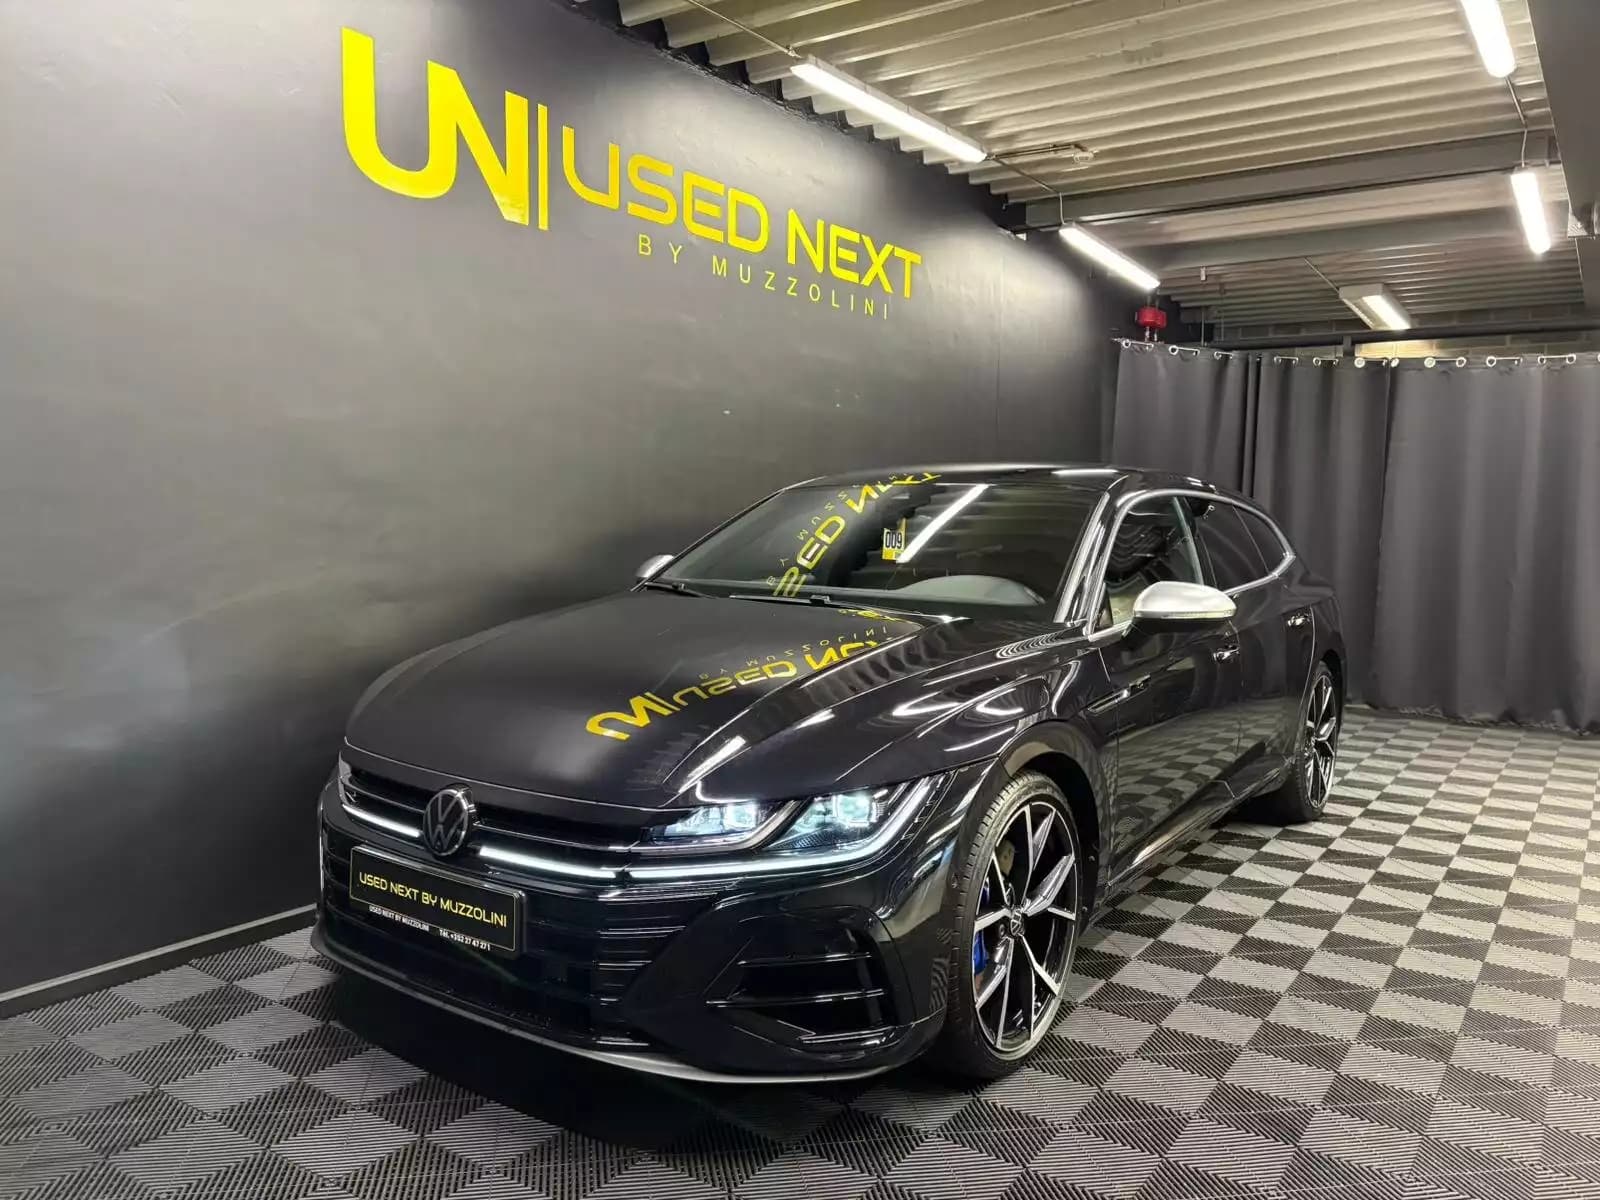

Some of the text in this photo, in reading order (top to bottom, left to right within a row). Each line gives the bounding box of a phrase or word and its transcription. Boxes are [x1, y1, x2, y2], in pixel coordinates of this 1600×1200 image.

[562, 125, 922, 299] USED NEXT
[638, 234, 890, 321] BY MUZZOLINI
[885, 531, 902, 549] 009
[359, 871, 507, 928] USED NEXT BY MUZZOLINI
